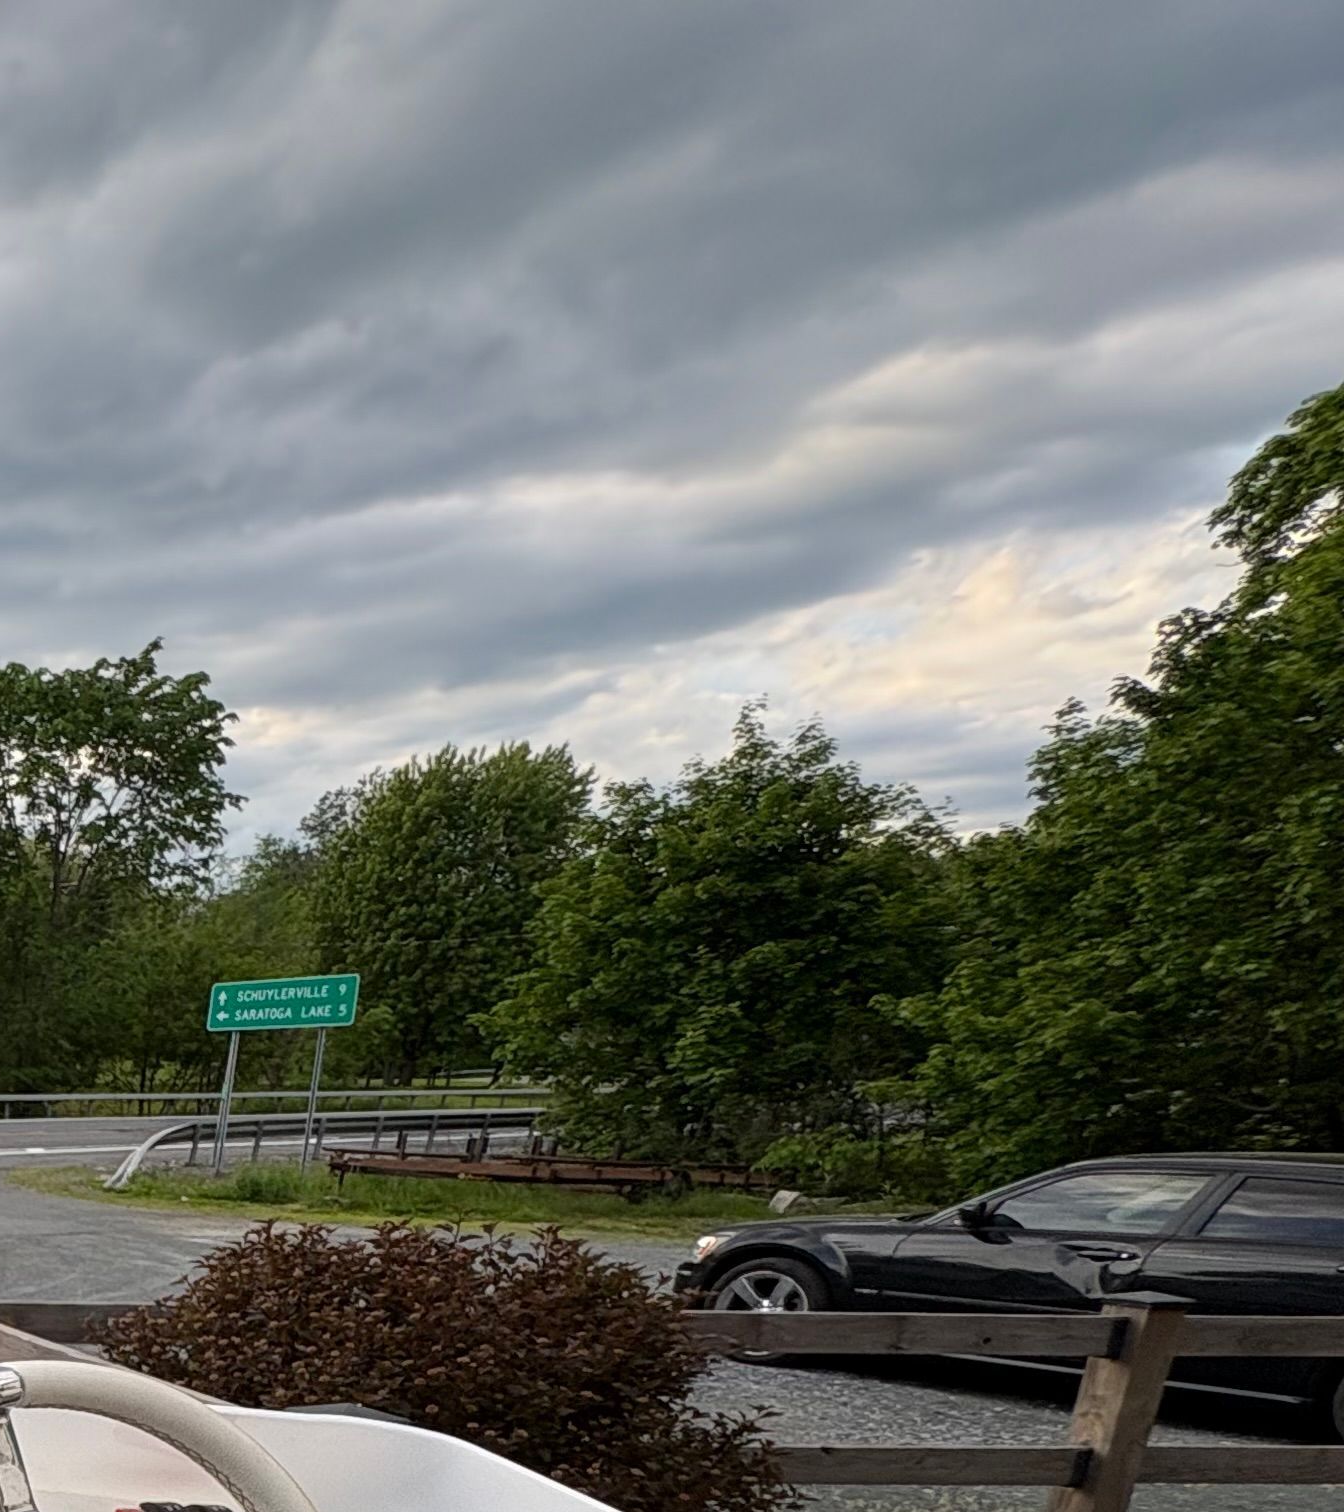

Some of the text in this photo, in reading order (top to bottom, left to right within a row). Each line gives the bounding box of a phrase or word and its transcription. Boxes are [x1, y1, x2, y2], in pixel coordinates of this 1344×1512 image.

[237, 984, 347, 1002] SCHUYLERVILLE 9
[234, 1004, 347, 1021] SARATOGA LAKE 5
